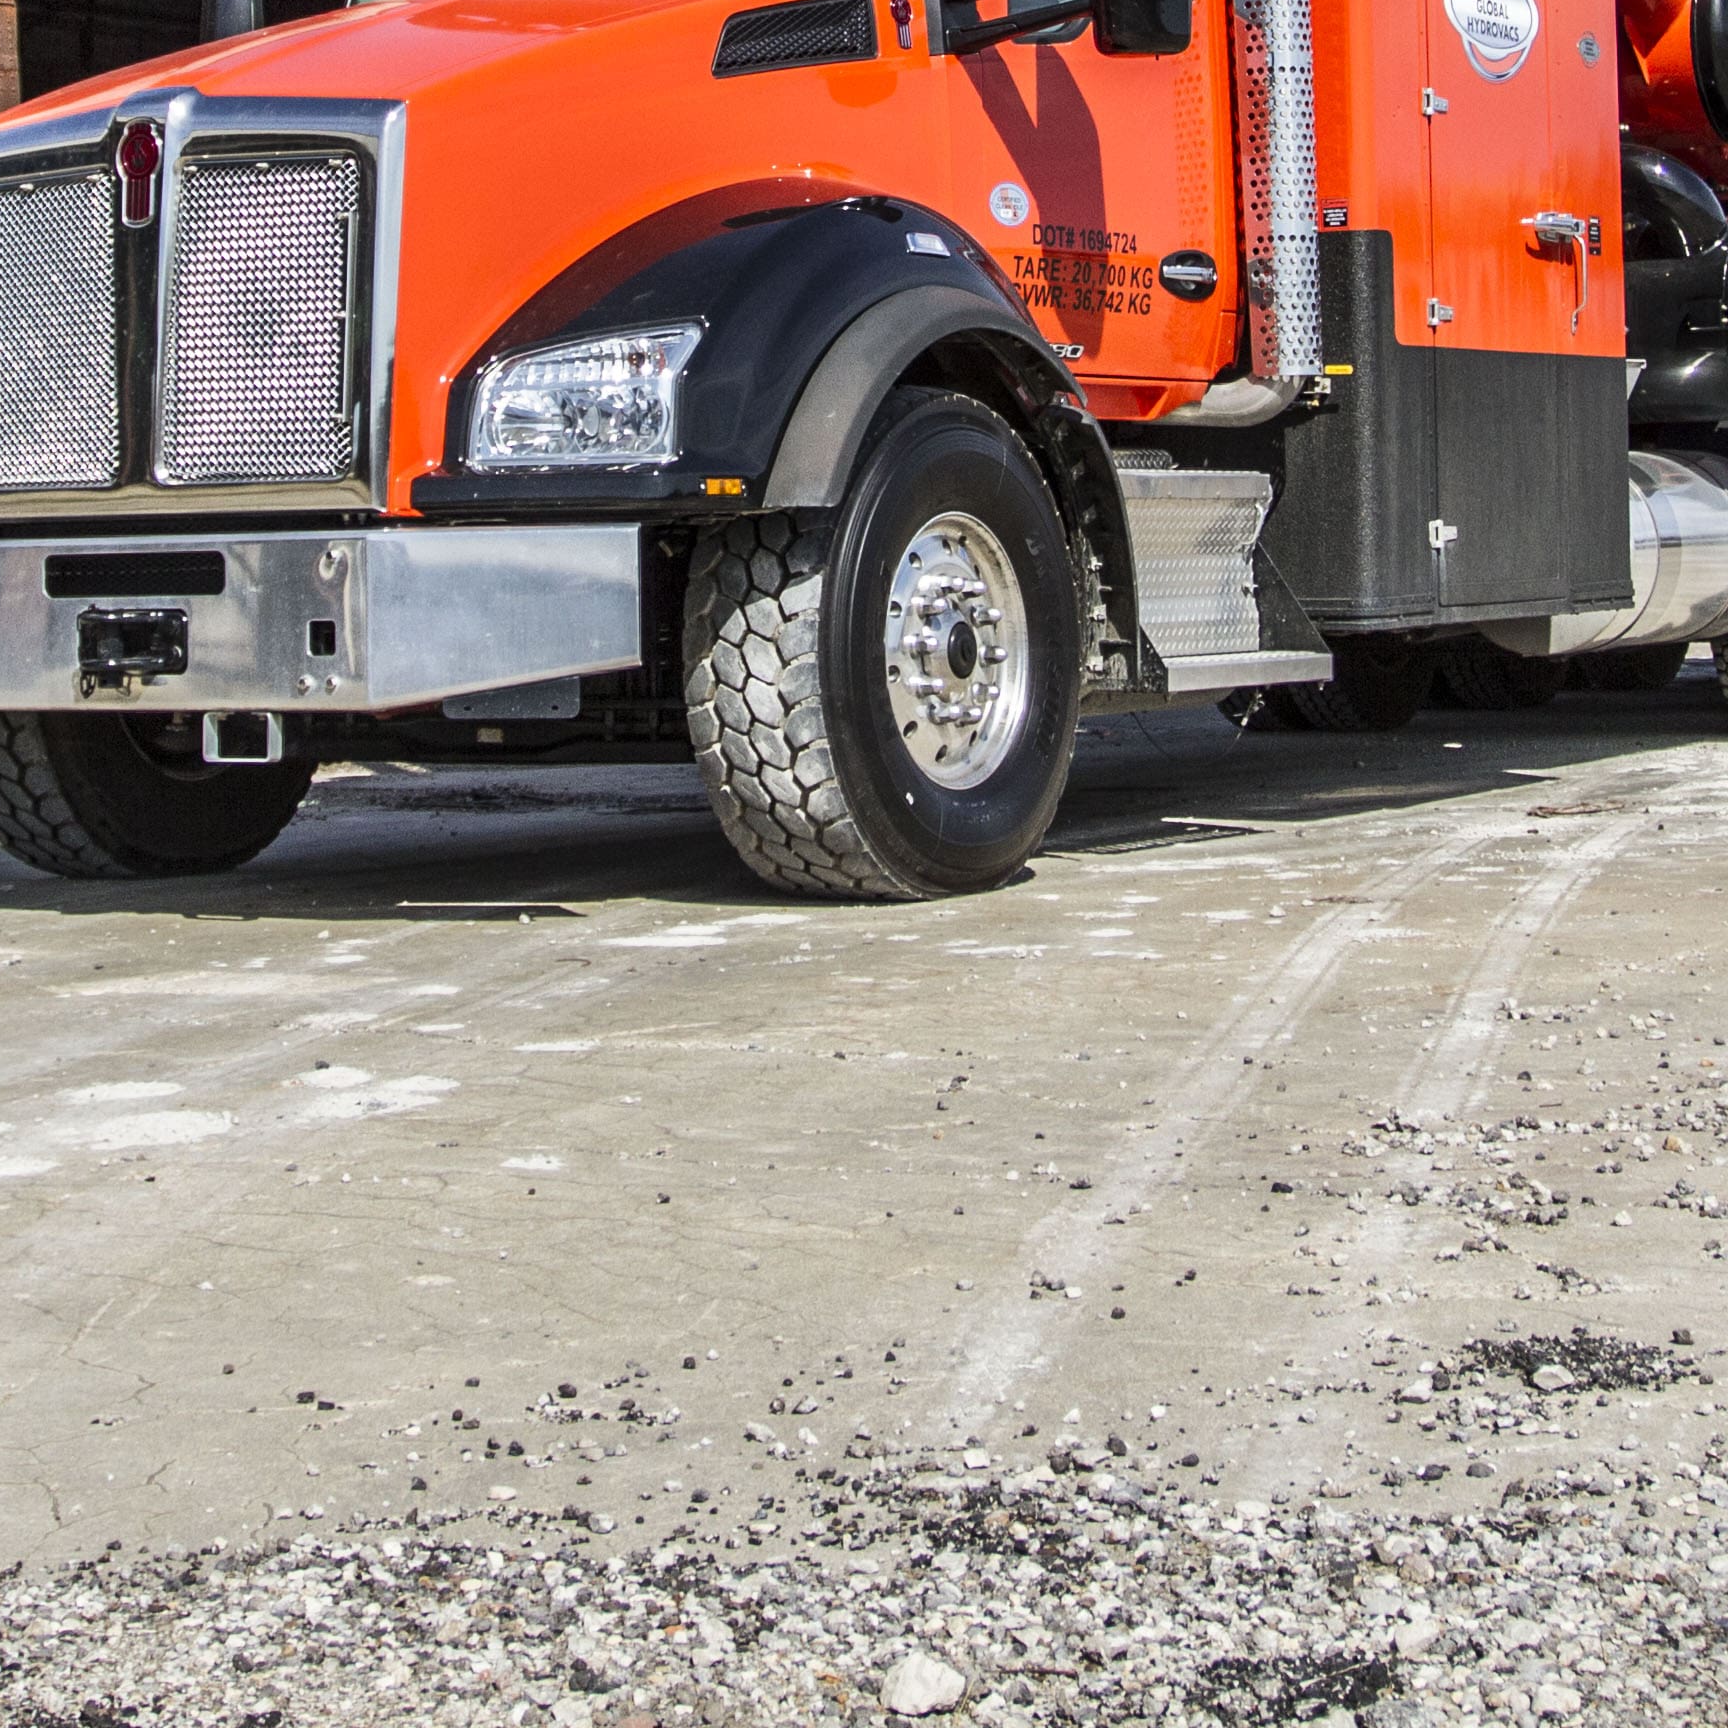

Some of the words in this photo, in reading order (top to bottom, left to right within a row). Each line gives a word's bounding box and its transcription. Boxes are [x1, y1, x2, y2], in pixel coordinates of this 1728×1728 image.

[1466, 15, 1520, 43] HYDROVACS
[1032, 223, 1075, 247] DOT#
[1079, 229, 1137, 254] 1694724
[1013, 255, 1067, 282] TARE:
[1072, 261, 1126, 288] 20,700
[1130, 266, 1153, 290] KG
[1073, 287, 1124, 315] 36,742
[1128, 293, 1151, 315] KG
